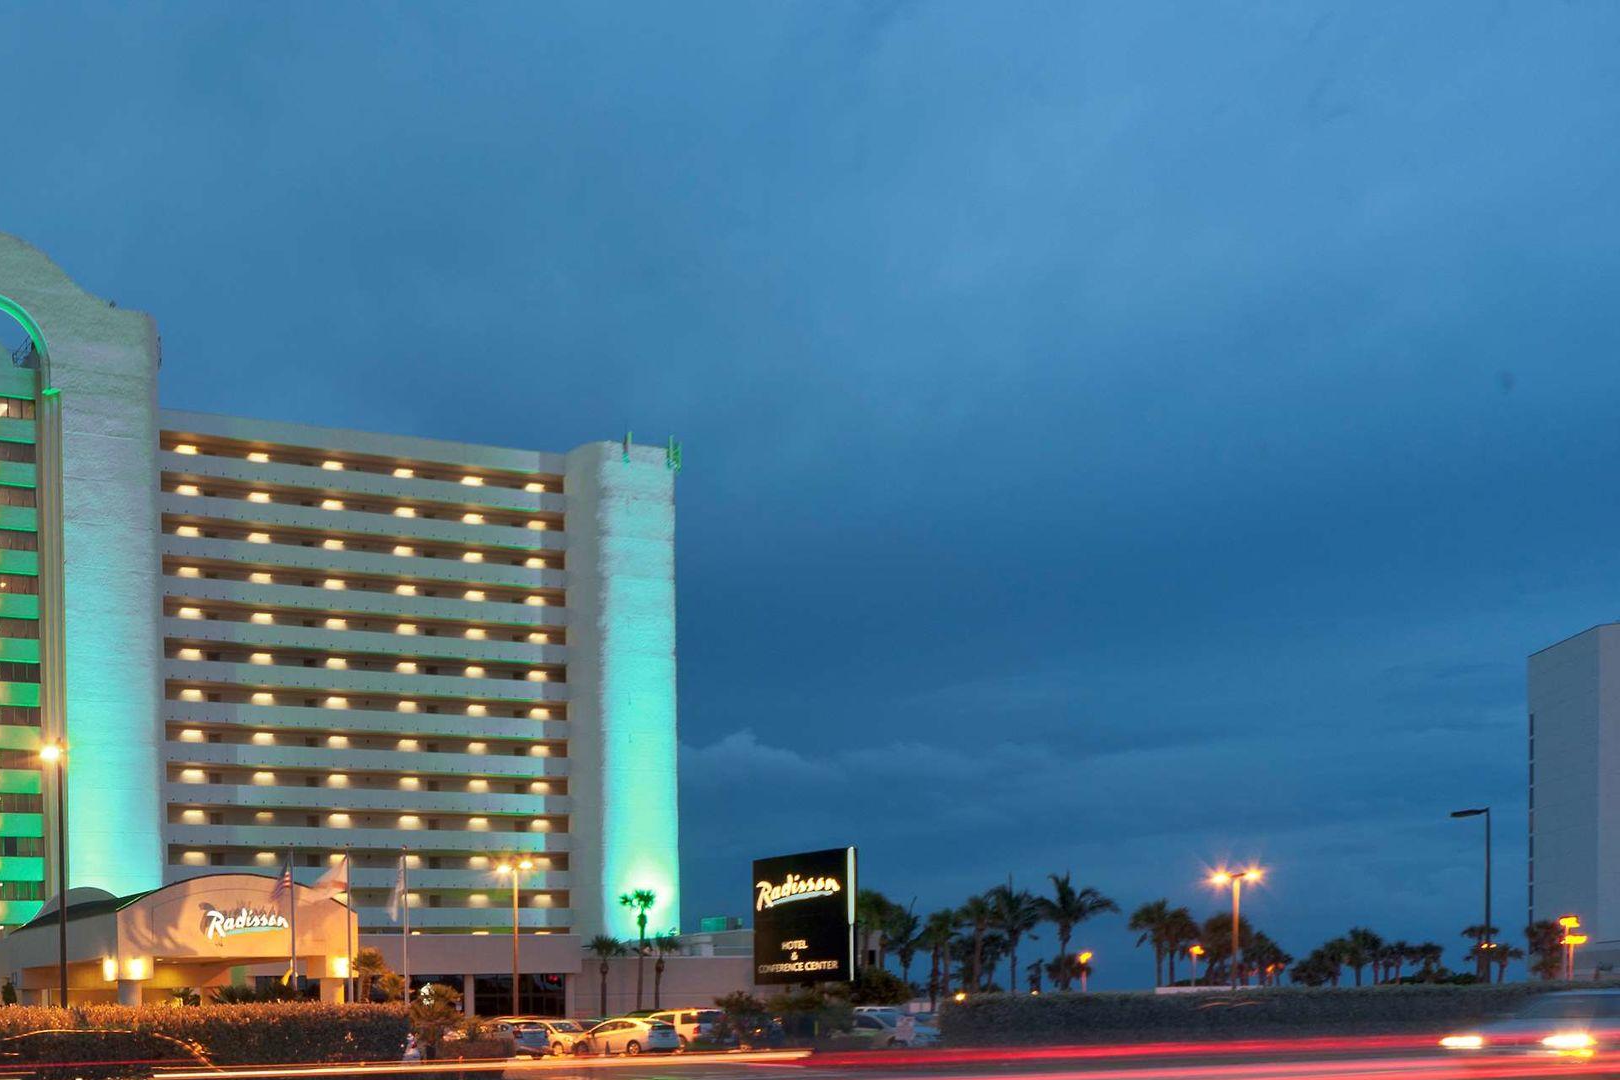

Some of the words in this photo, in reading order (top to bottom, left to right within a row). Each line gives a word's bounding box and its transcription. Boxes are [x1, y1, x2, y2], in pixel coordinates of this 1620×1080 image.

[756, 874, 840, 911] Radisson
[207, 908, 289, 940] Radisson
[781, 940, 808, 950] HOTEL
[790, 951, 799, 961] &
[759, 962, 804, 973] CONFERENCE
[804, 960, 838, 971] CENTER
